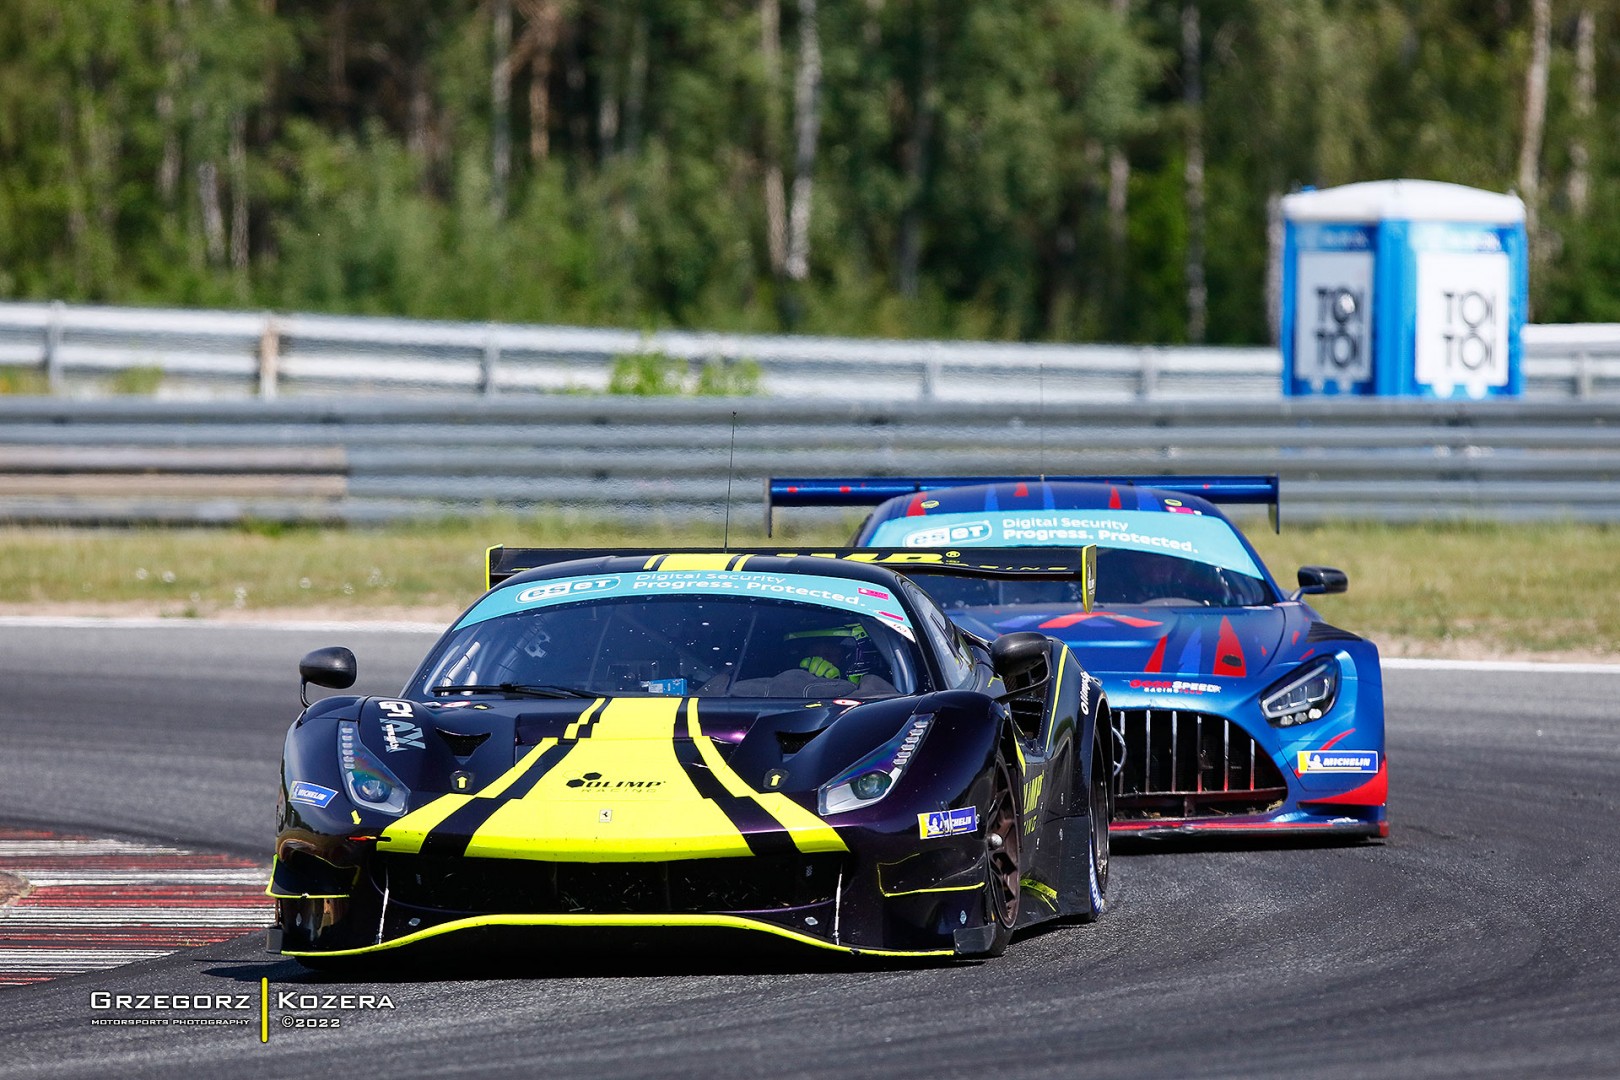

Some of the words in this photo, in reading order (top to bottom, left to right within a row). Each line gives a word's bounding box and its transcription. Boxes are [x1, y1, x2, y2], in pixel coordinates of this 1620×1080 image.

[1315, 287, 1363, 323] TOI
[1443, 290, 1497, 328] TOI
[1315, 330, 1363, 369] TOI
[1443, 333, 1497, 371] TOI
[1002, 516, 1058, 529] Digital
[1060, 517, 1129, 532] Security
[1003, 528, 1095, 541] Progress.
[1099, 530, 1200, 554] Protected.
[635, 573, 701, 583] Digital
[704, 573, 787, 584] Security
[632, 577, 741, 590] Progress.
[746, 581, 866, 607] Protected.
[1322, 757, 1371, 767] MICHELIN
[296, 788, 328, 801] MICHELIN
[584, 780, 662, 788] OLIMP
